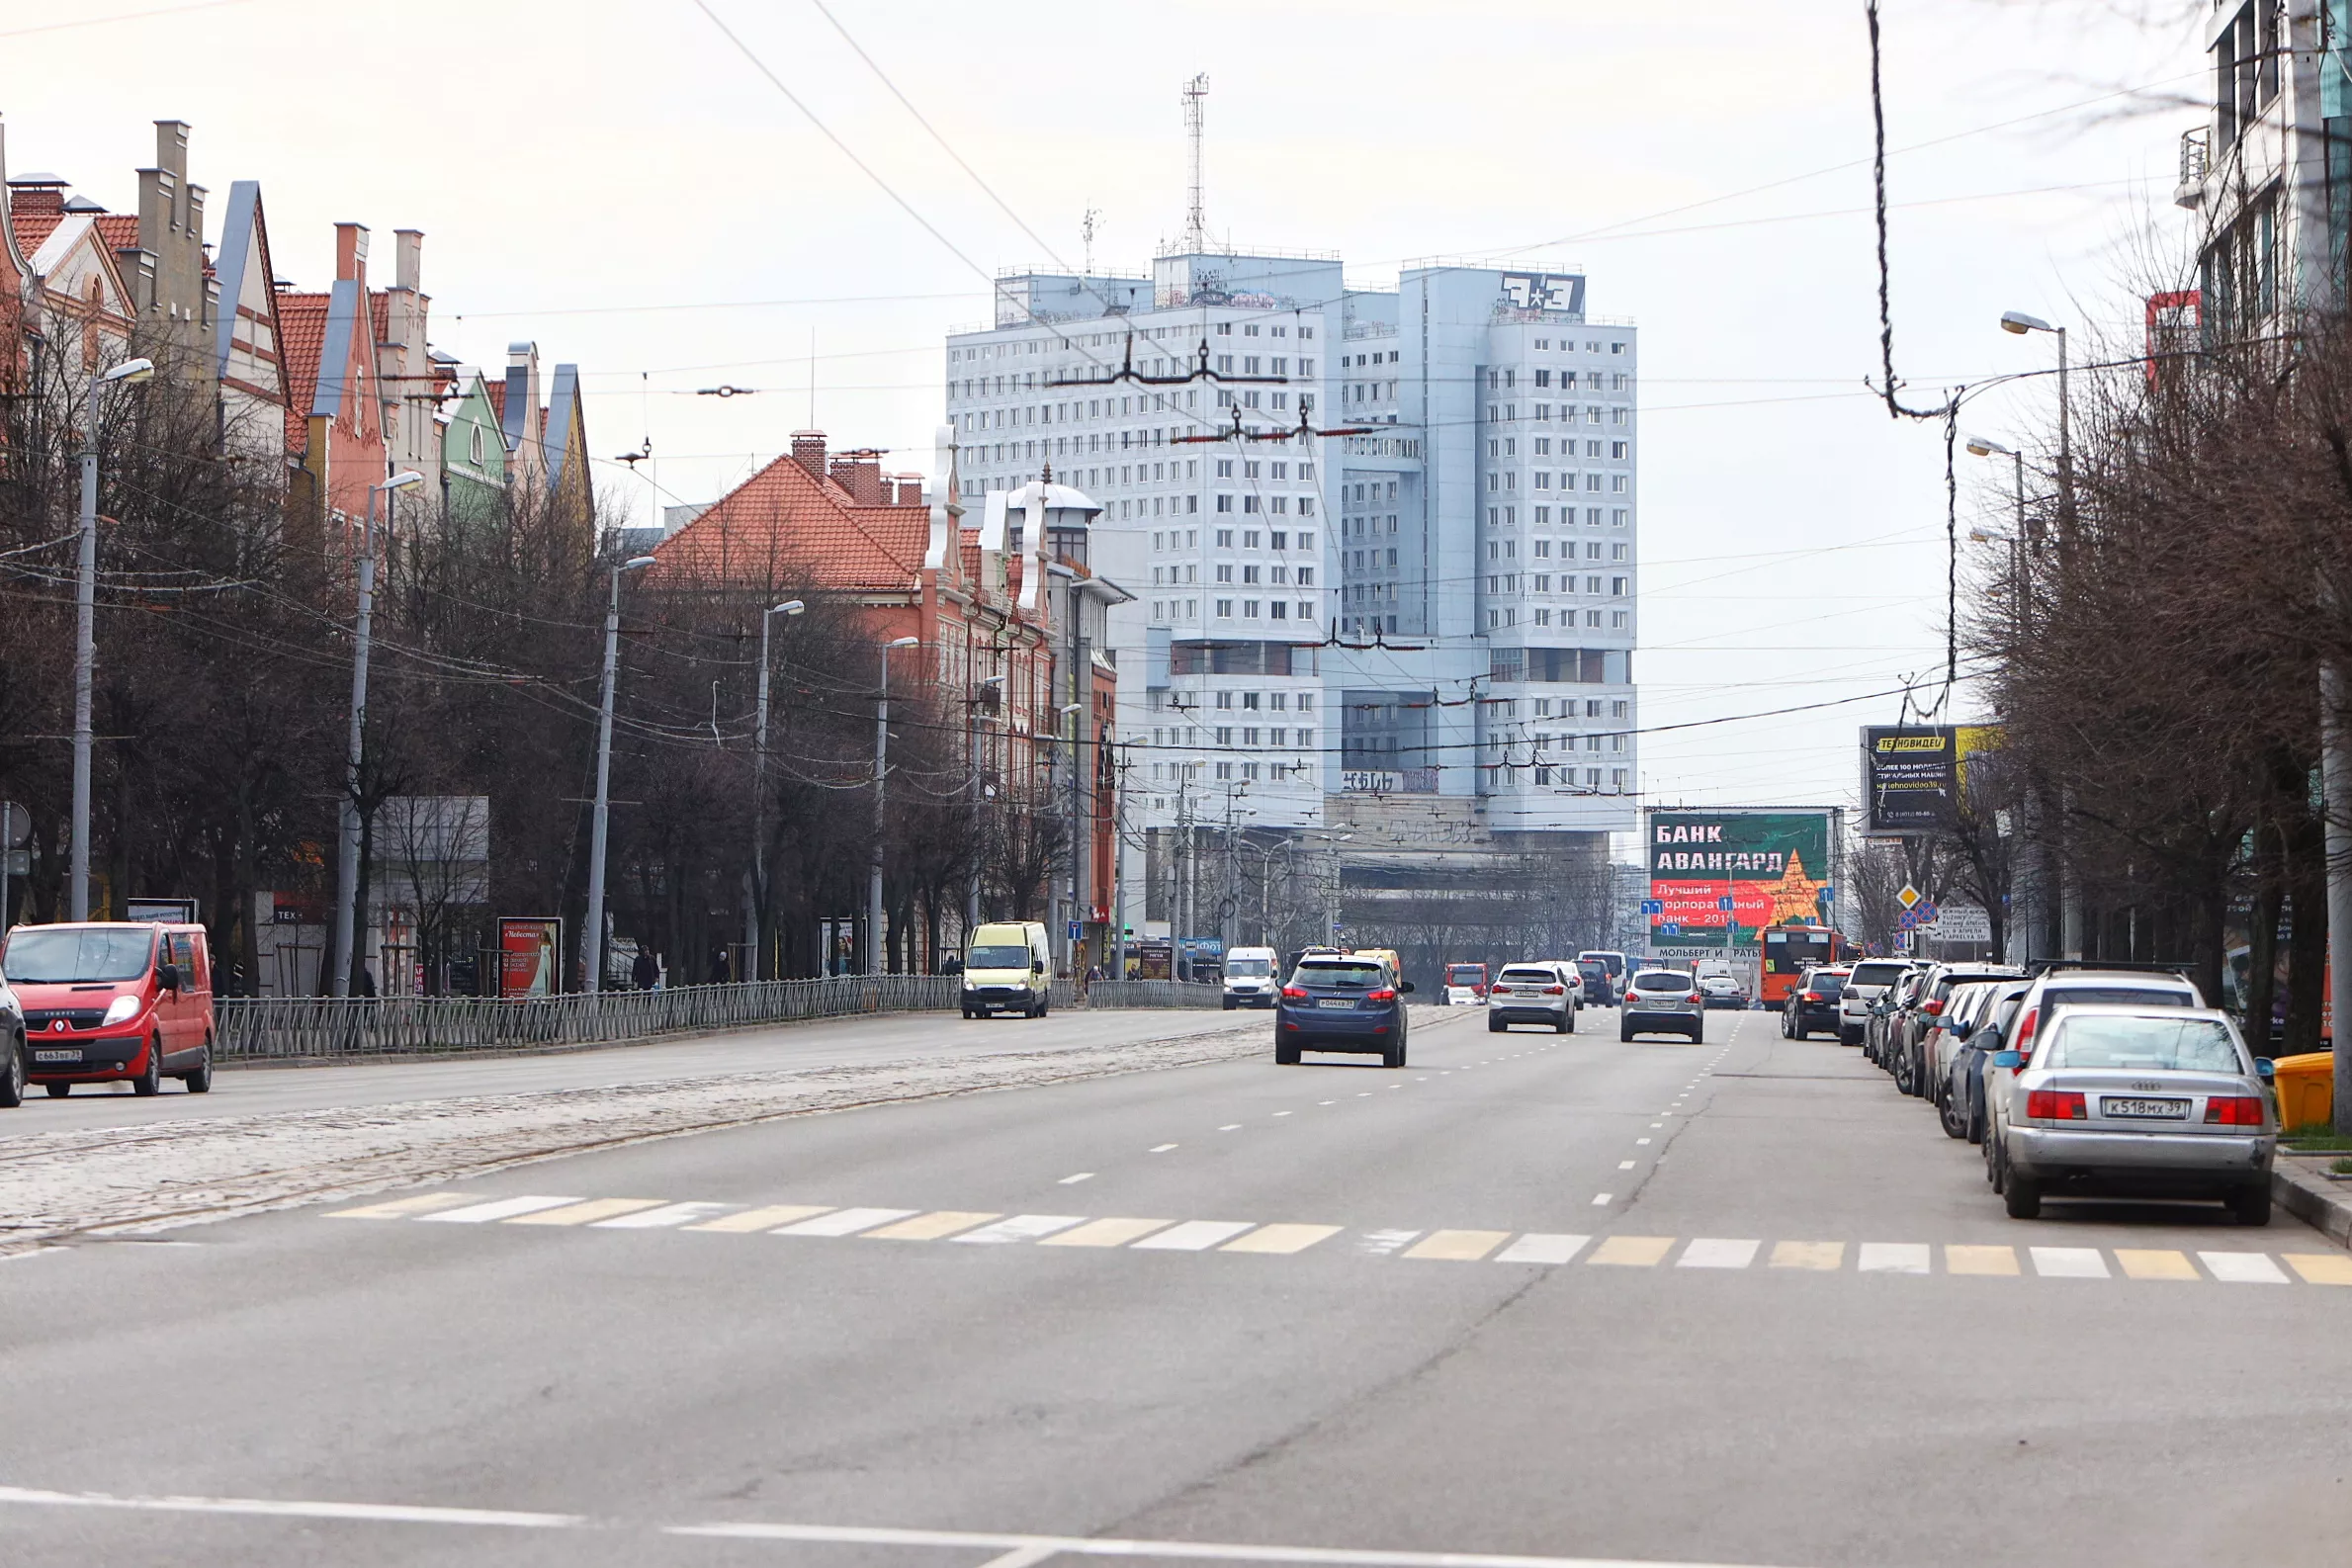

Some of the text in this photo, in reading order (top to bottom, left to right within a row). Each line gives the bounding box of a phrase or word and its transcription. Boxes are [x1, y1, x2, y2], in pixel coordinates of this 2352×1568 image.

[1656, 826, 1722, 843] БАНК
[1657, 852, 1784, 872] АВАНГАРД
[1657, 884, 1711, 895] Лучший
[1662, 900, 1765, 911] орпоратвный
[1733, 949, 1762, 958] РАТЬ
[2111, 1100, 2181, 1114] К518МХ 39
